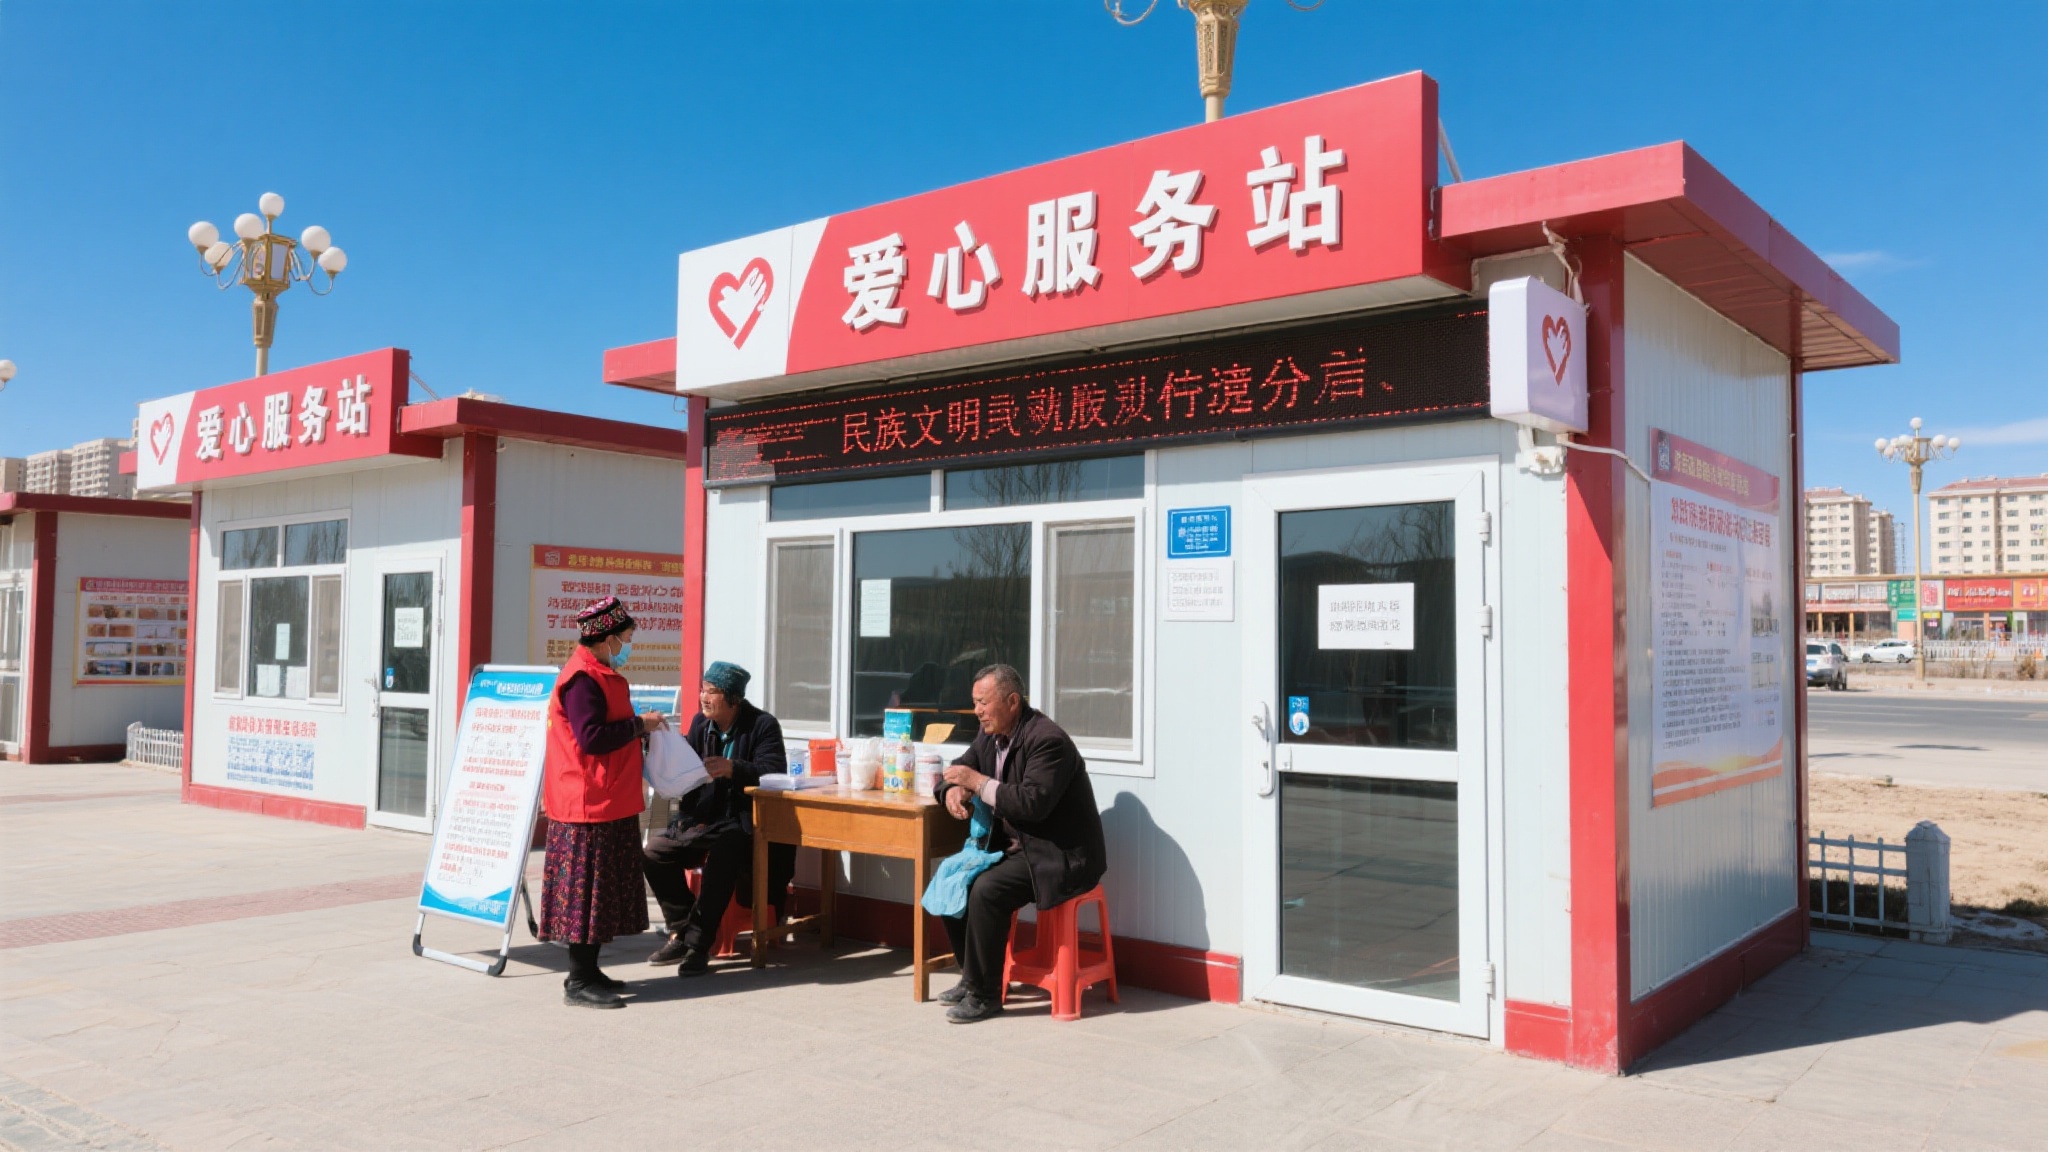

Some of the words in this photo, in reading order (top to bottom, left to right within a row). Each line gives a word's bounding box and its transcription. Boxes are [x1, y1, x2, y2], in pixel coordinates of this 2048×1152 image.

[841, 135, 1346, 332] 爱心服务站
[196, 374, 372, 461] 爱心服务站
